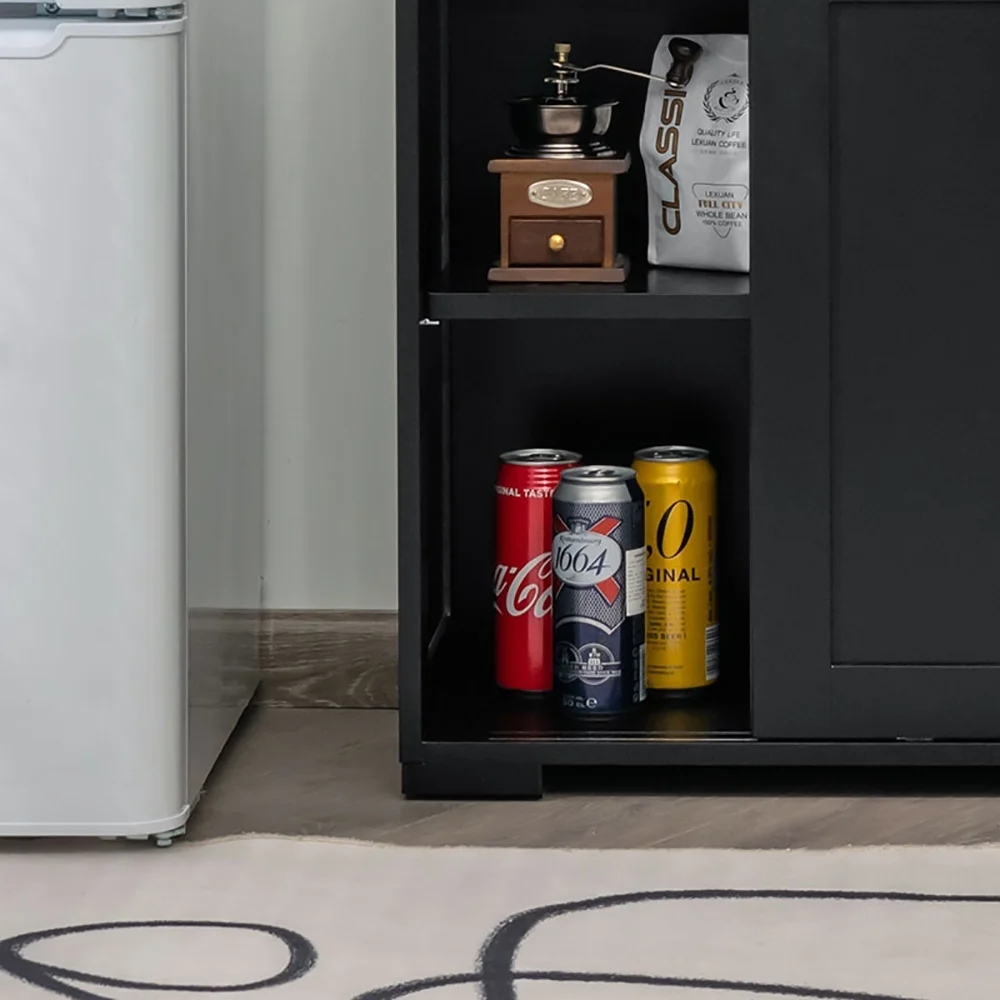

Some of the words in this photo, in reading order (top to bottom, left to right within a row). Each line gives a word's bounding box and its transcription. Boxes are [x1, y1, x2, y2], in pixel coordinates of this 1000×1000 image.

[656, 89, 687, 236] CLASSI
[695, 210, 724, 219] WHOLE
[725, 211, 748, 220] BEAN
[555, 543, 611, 576] 1664
[646, 567, 701, 582] GINAL
